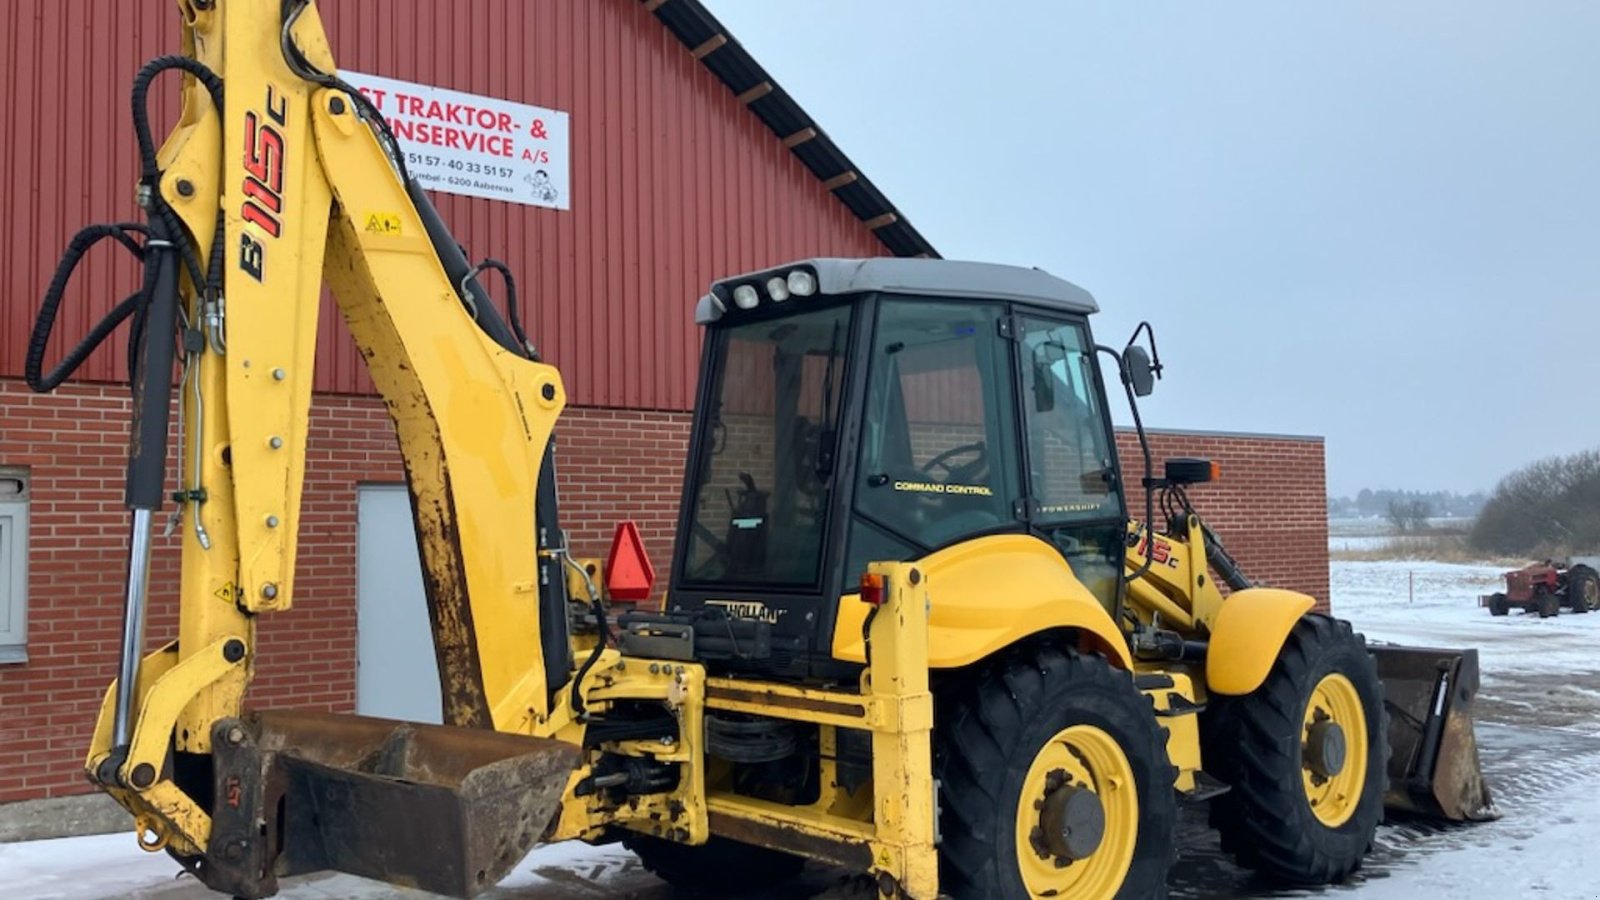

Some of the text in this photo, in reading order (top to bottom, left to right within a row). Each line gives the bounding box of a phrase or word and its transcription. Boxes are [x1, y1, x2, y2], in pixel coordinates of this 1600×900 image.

[395, 93, 522, 133] TRAKTOR-
[530, 118, 548, 139] &
[522, 149, 549, 164] A/S
[409, 153, 423, 164] 51
[425, 155, 440, 167] 57
[448, 159, 464, 171] 40
[466, 162, 481, 173] 33
[484, 165, 497, 176] 51
[499, 168, 514, 178] 57
[447, 176, 472, 188] 6200
[894, 481, 993, 496] COMMAND CONTROL
[1042, 503, 1101, 513] POWERSHIFT
